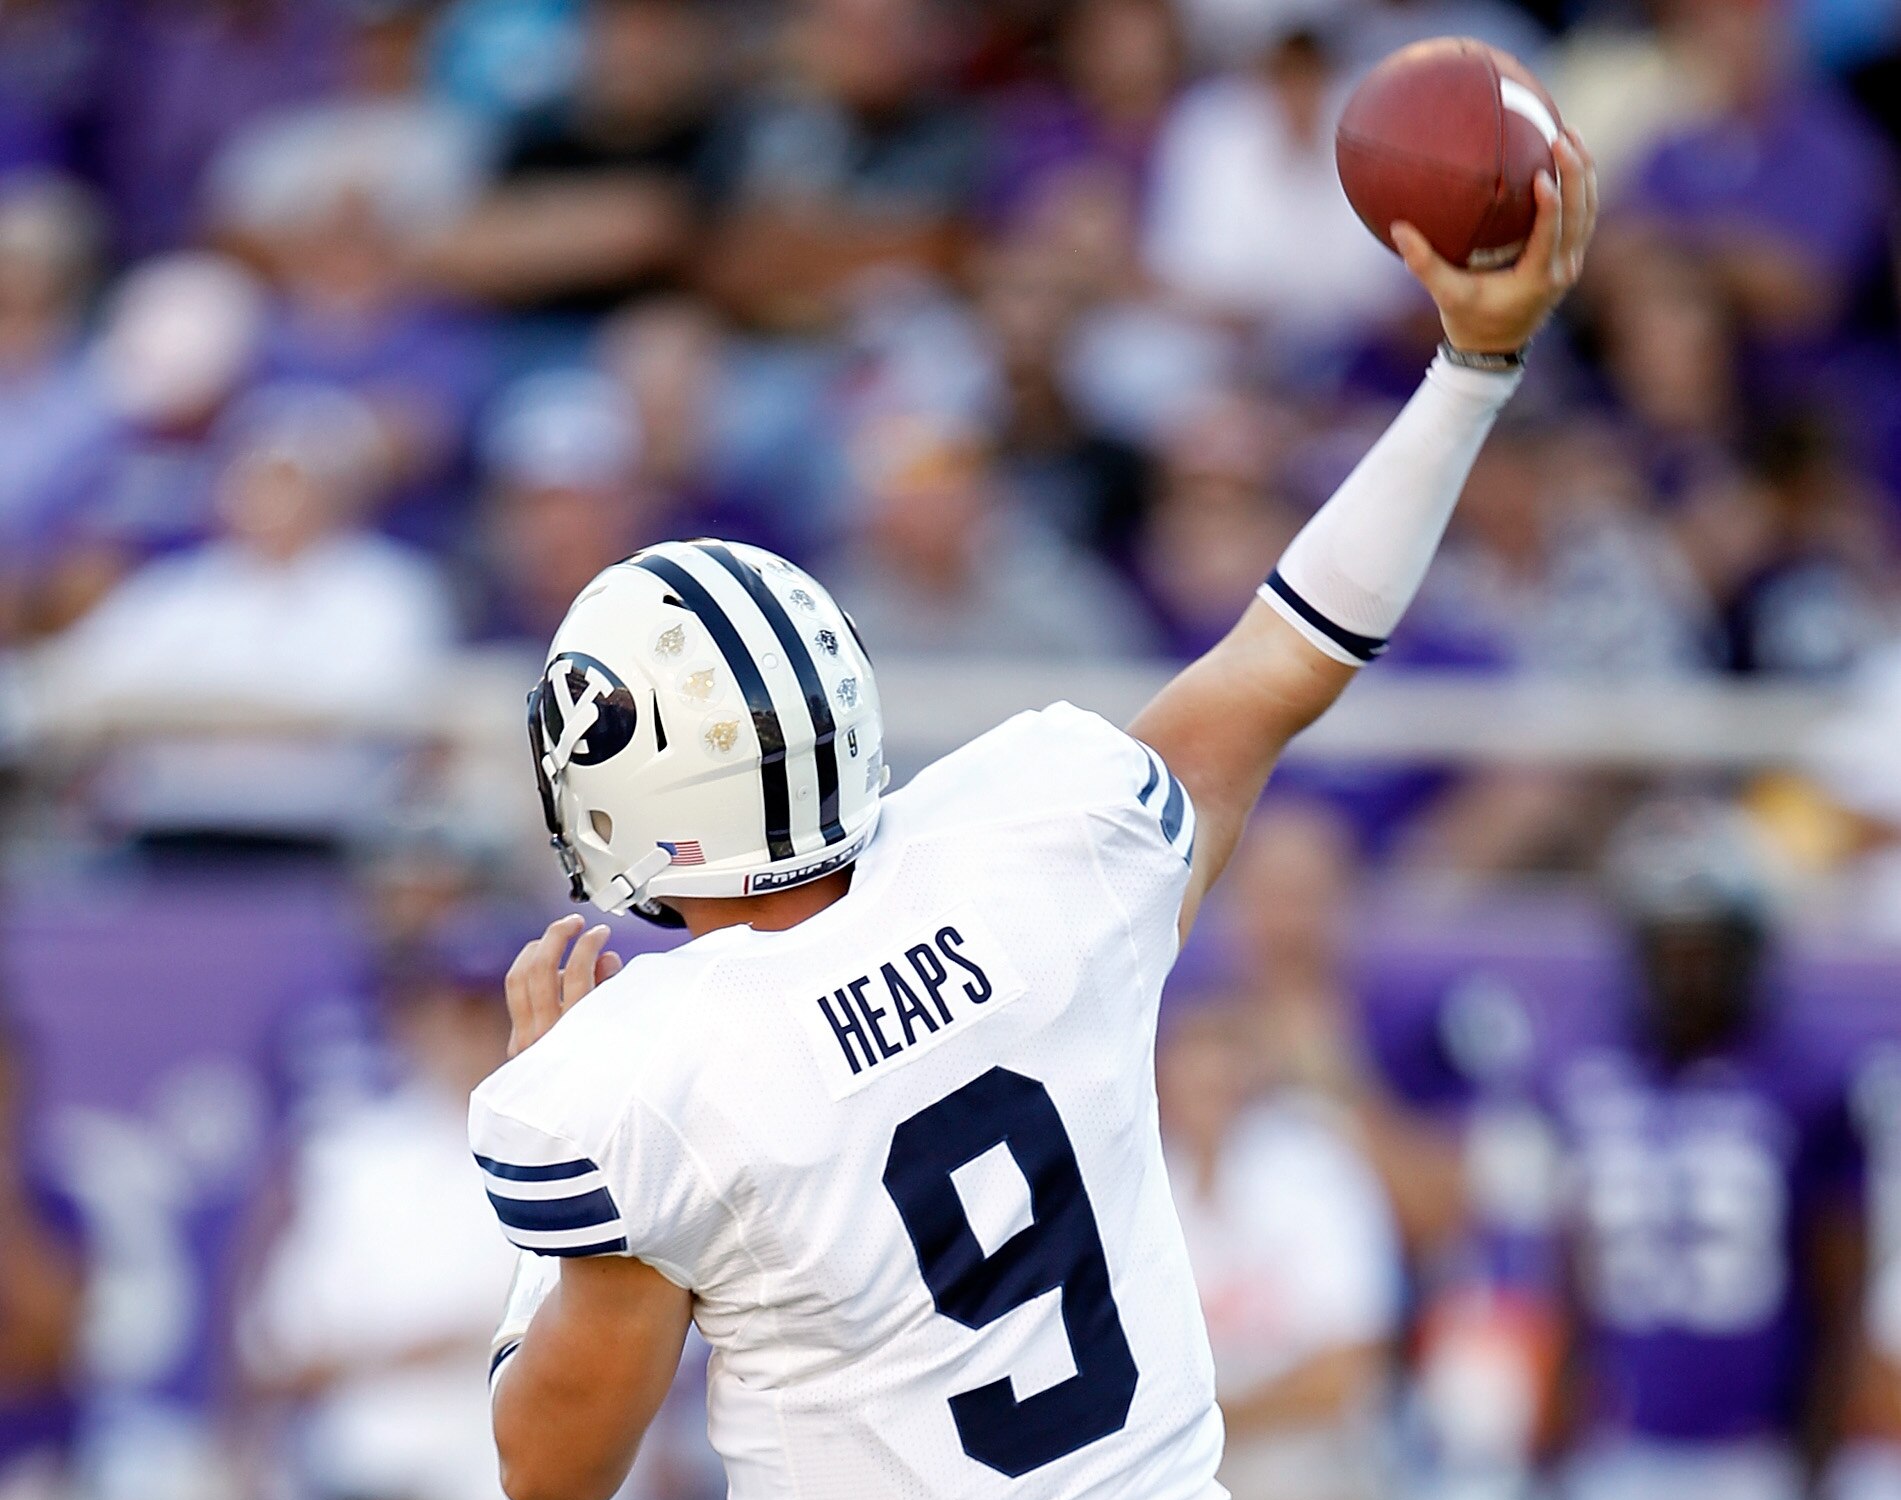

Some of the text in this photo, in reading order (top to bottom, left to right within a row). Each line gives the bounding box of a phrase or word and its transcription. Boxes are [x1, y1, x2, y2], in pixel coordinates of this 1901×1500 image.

[847, 728, 858, 758] 9
[817, 925, 993, 1076] HEAPS
[882, 1065, 1139, 1479] 9
